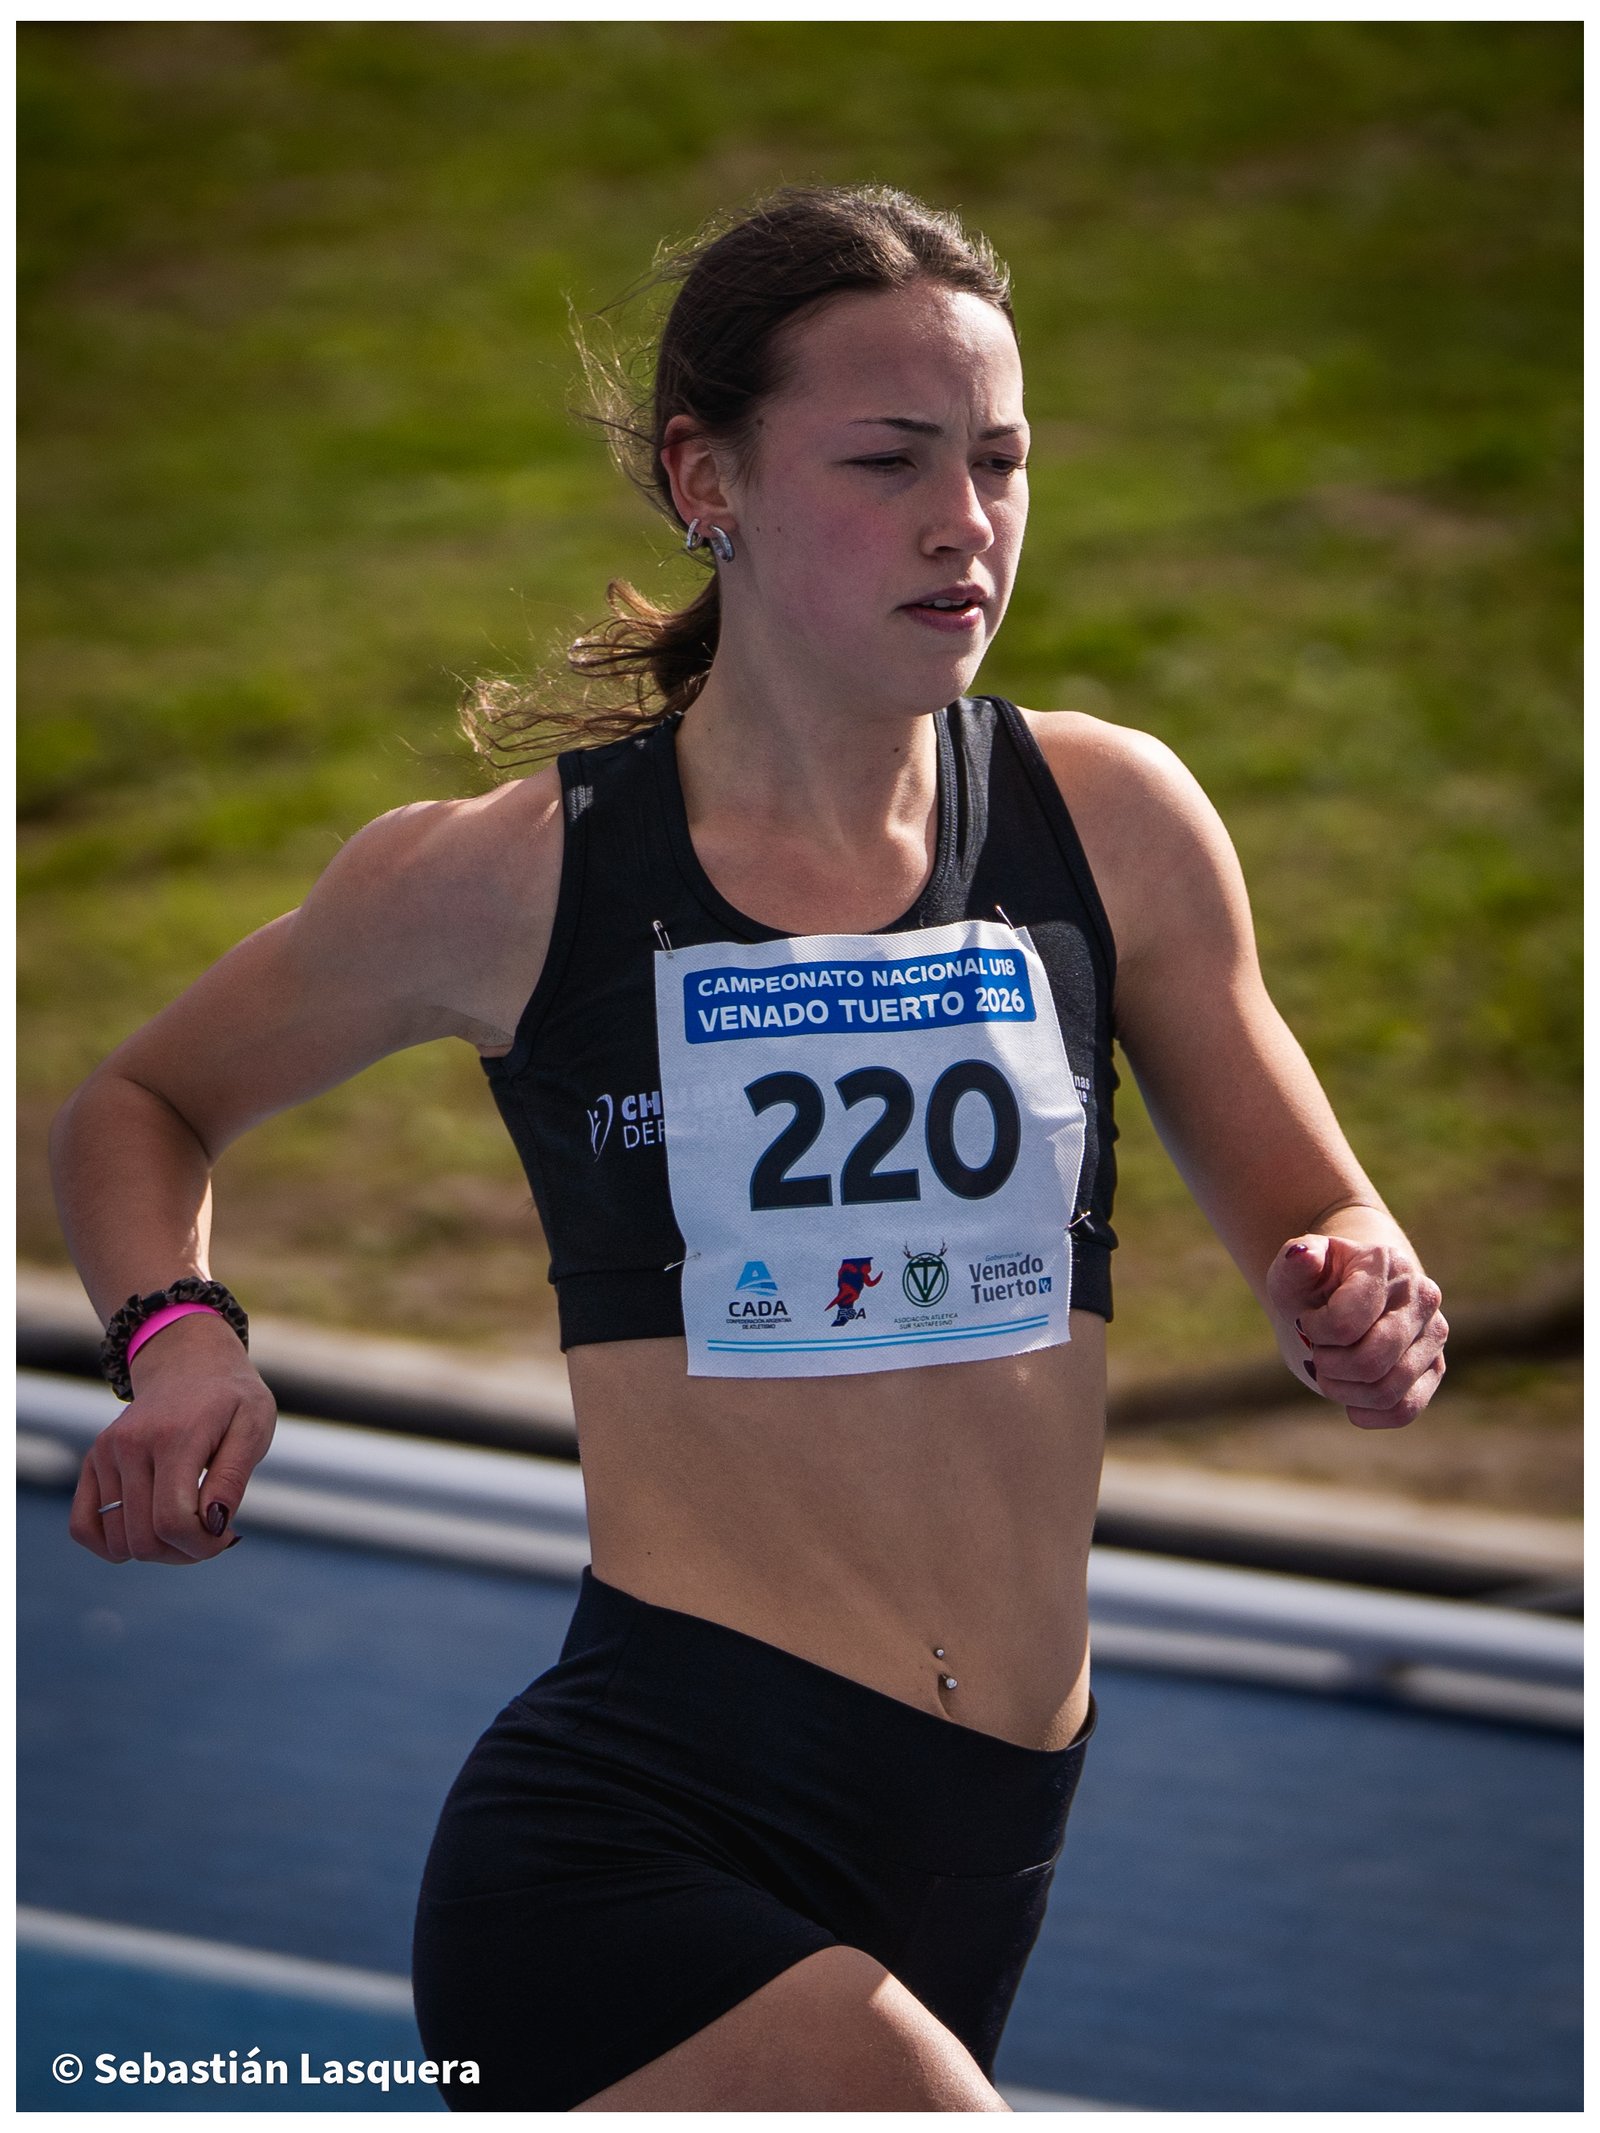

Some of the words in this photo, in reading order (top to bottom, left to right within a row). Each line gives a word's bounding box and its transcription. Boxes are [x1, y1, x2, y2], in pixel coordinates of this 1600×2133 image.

[698, 970, 864, 996] CAMPEONATO
[873, 958, 989, 987] NACIONAL
[989, 958, 1016, 976] U18
[698, 999, 828, 1033] VENADO
[838, 991, 964, 1024] TUERTO
[975, 987, 1025, 1013] 2026
[744, 1058, 1021, 1211] 220
[968, 1254, 1044, 1283] Venado
[970, 1279, 1037, 1304] Tuerto
[728, 1300, 788, 1317] CADA
